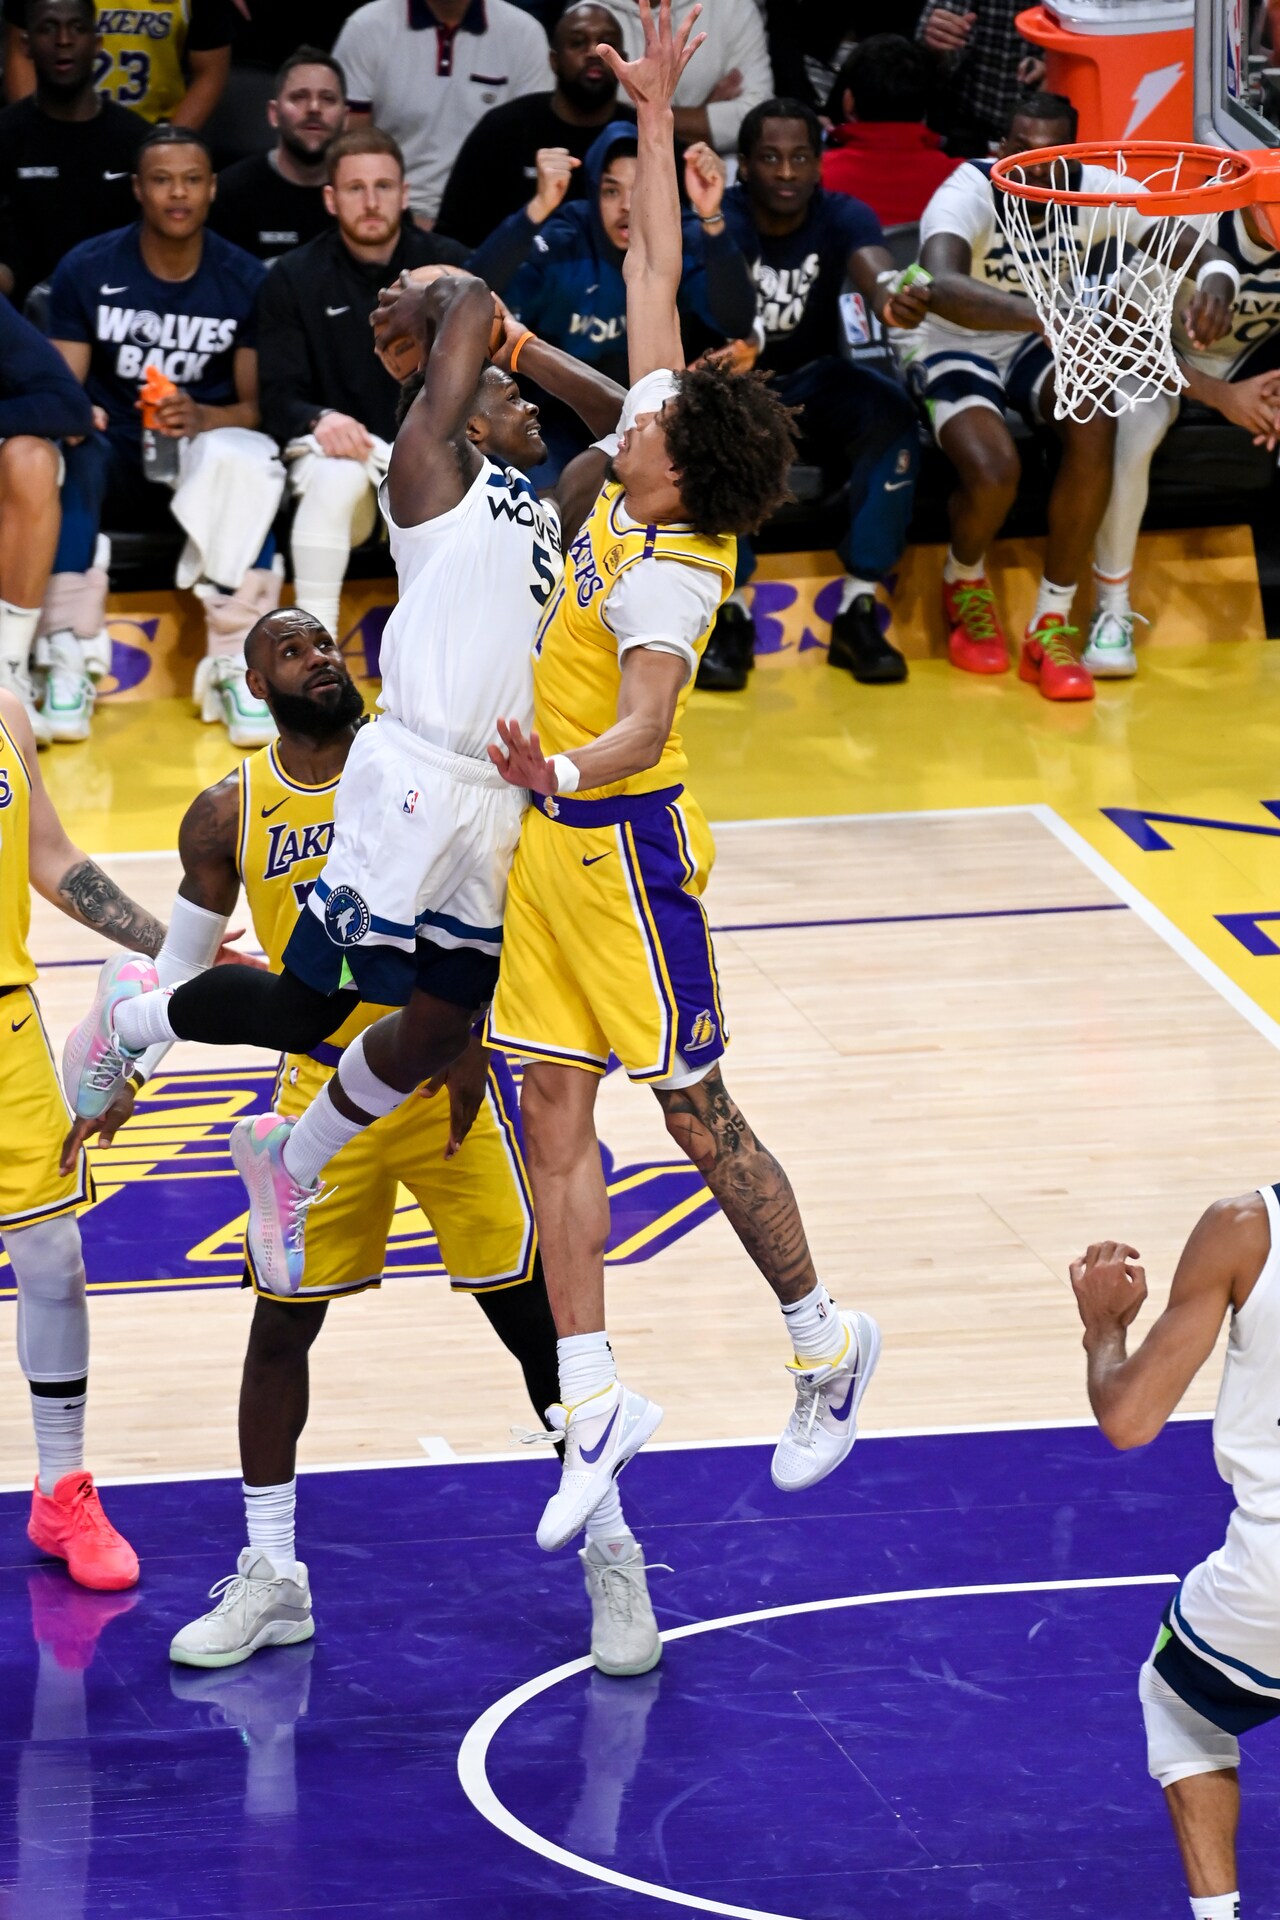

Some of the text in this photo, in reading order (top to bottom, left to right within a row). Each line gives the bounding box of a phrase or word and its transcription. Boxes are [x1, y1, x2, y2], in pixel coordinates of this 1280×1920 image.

[96, 10, 173, 39] KERS
[116, 344, 211, 383] BACK
[529, 539, 556, 607] 5
[351, 891, 369, 942] TIMBERWOLVES
